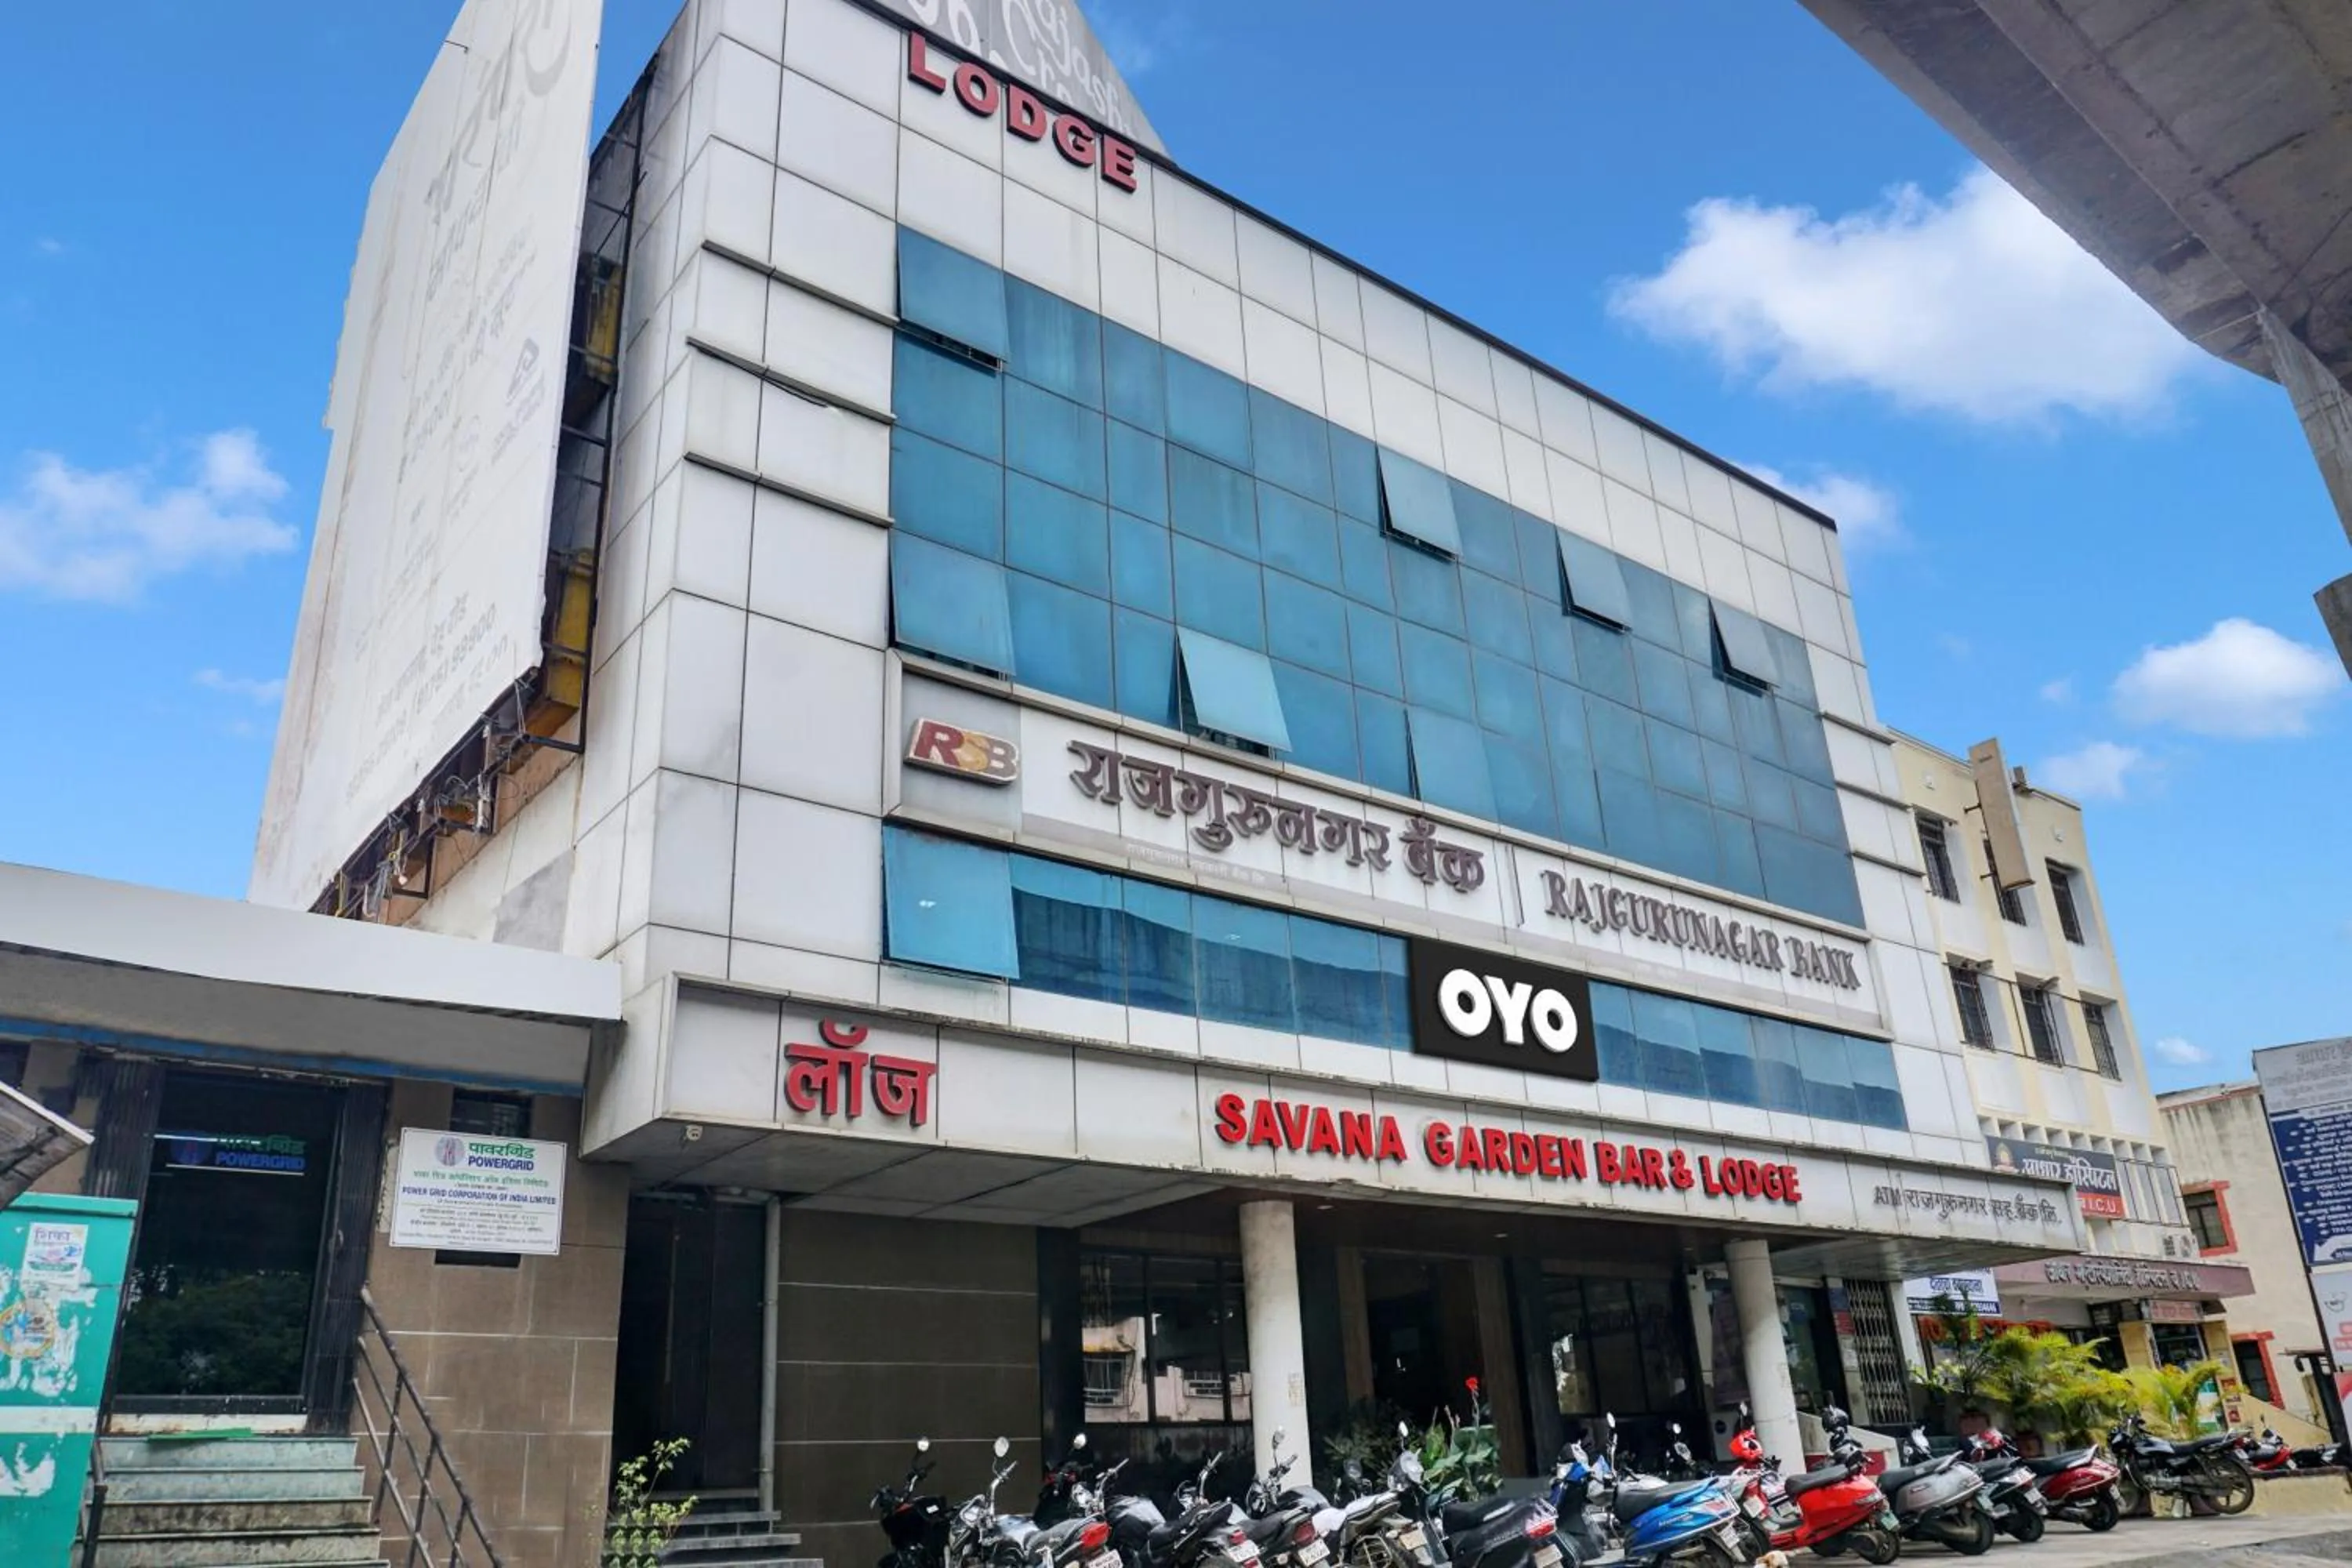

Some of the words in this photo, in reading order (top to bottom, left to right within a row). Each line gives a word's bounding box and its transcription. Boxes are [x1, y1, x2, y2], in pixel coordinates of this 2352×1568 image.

[907, 30, 1138, 194] LODGE
[909, 718, 1018, 784] RSB
[1067, 739, 1392, 871] राजगुरुनगर
[1541, 869, 1785, 972] RAJGURUNAGAR
[1784, 935, 1860, 990] BANK
[1438, 968, 1578, 1054] OYO
[784, 1017, 937, 1127] लॉज
[215, 1151, 306, 1171] POWERGRID
[402, 1186, 427, 1196] POWER
[430, 1188, 446, 1197] GRID
[448, 1189, 498, 1201] CORPORATION
[498, 1192, 508, 1201] OF
[510, 1194, 528, 1203] INDIA
[529, 1196, 557, 1206] LIMITED
[468, 1156, 535, 1171] POWERGRID
[1214, 1093, 1408, 1163] SAVANA
[1424, 1121, 1588, 1181] GARDEN
[1698, 1155, 1802, 1203] LODGE
